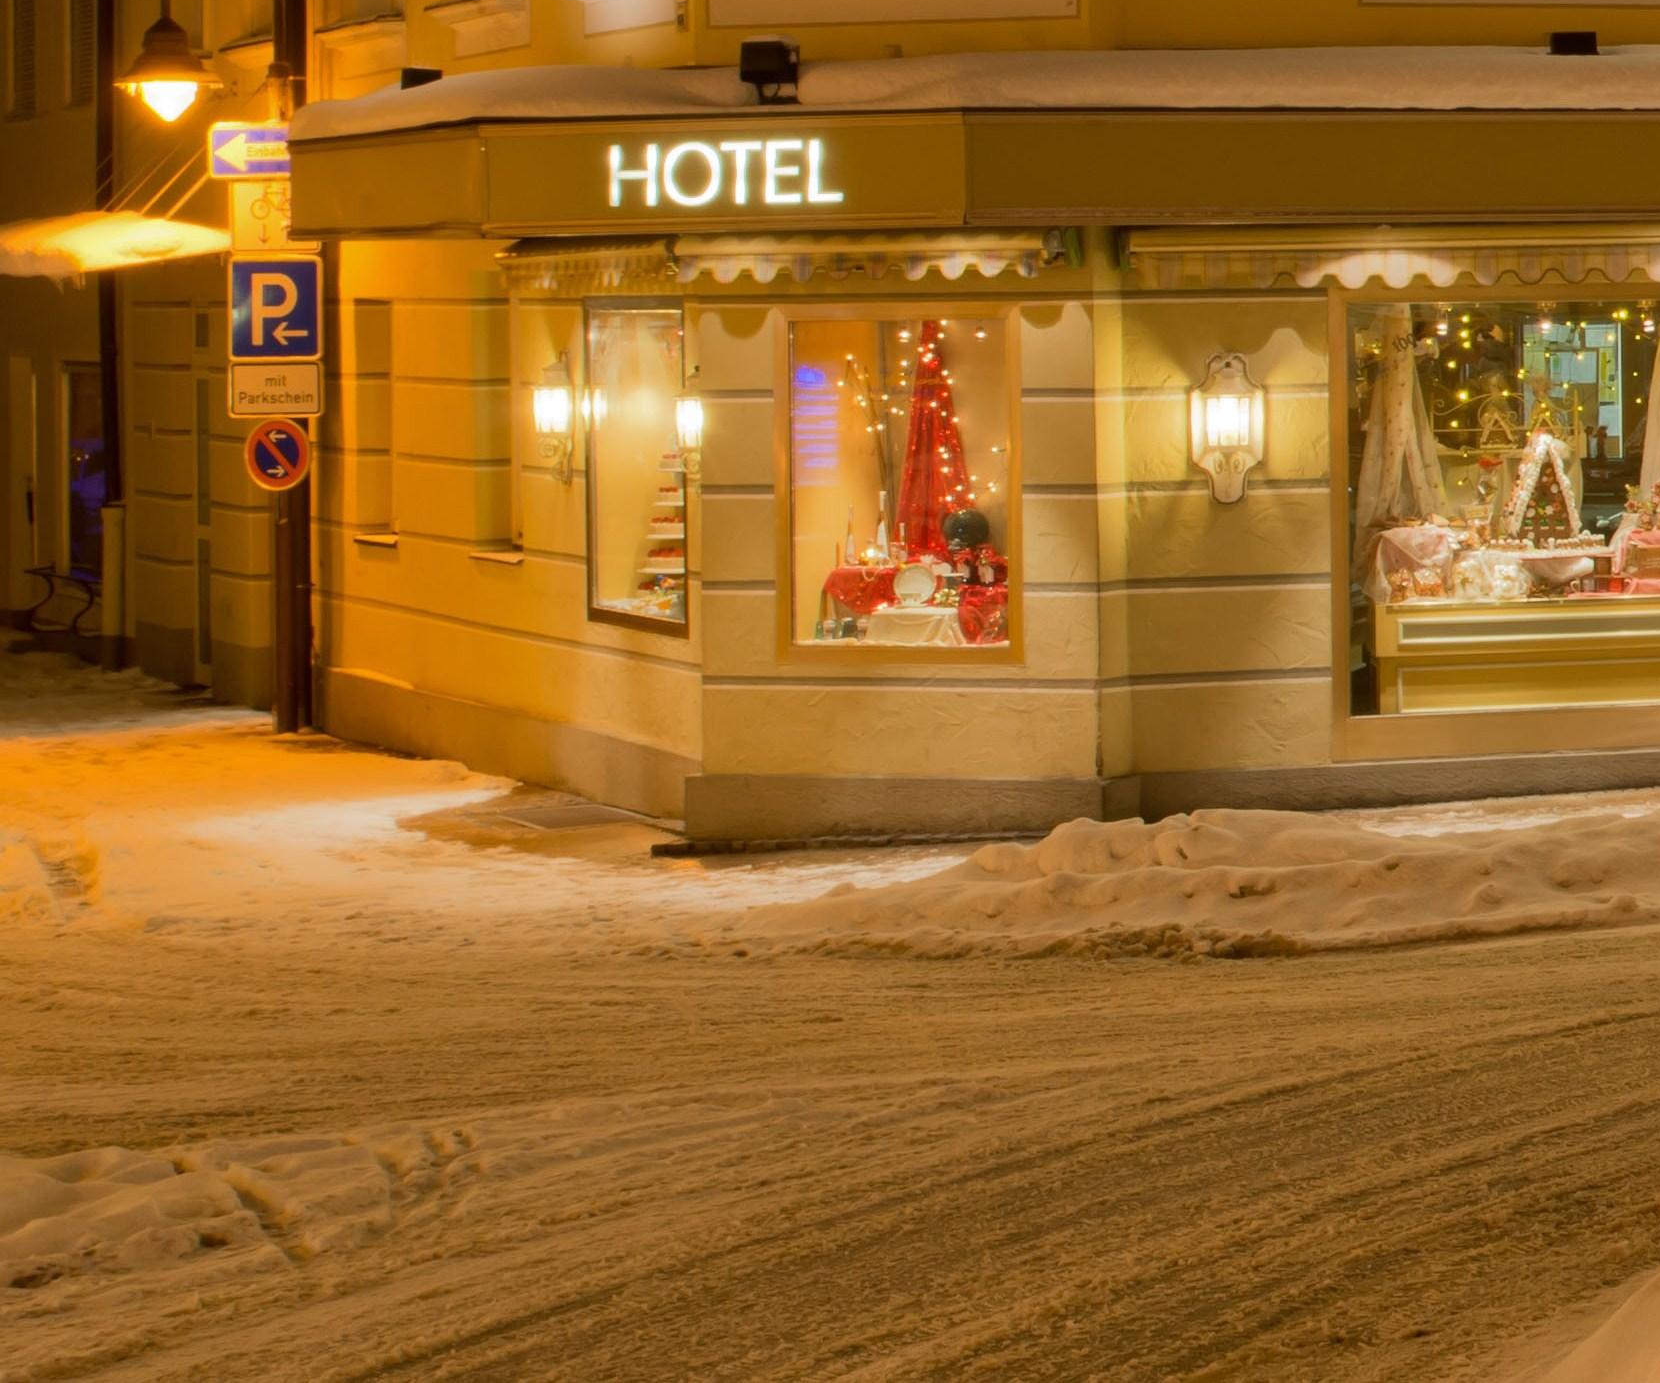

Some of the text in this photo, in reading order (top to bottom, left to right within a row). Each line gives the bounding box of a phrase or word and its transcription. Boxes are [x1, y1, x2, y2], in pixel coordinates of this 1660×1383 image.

[608, 137, 845, 207] HOTEL
[251, 272, 298, 346] P
[239, 391, 314, 404] Parkschein
[264, 375, 287, 387] mit
